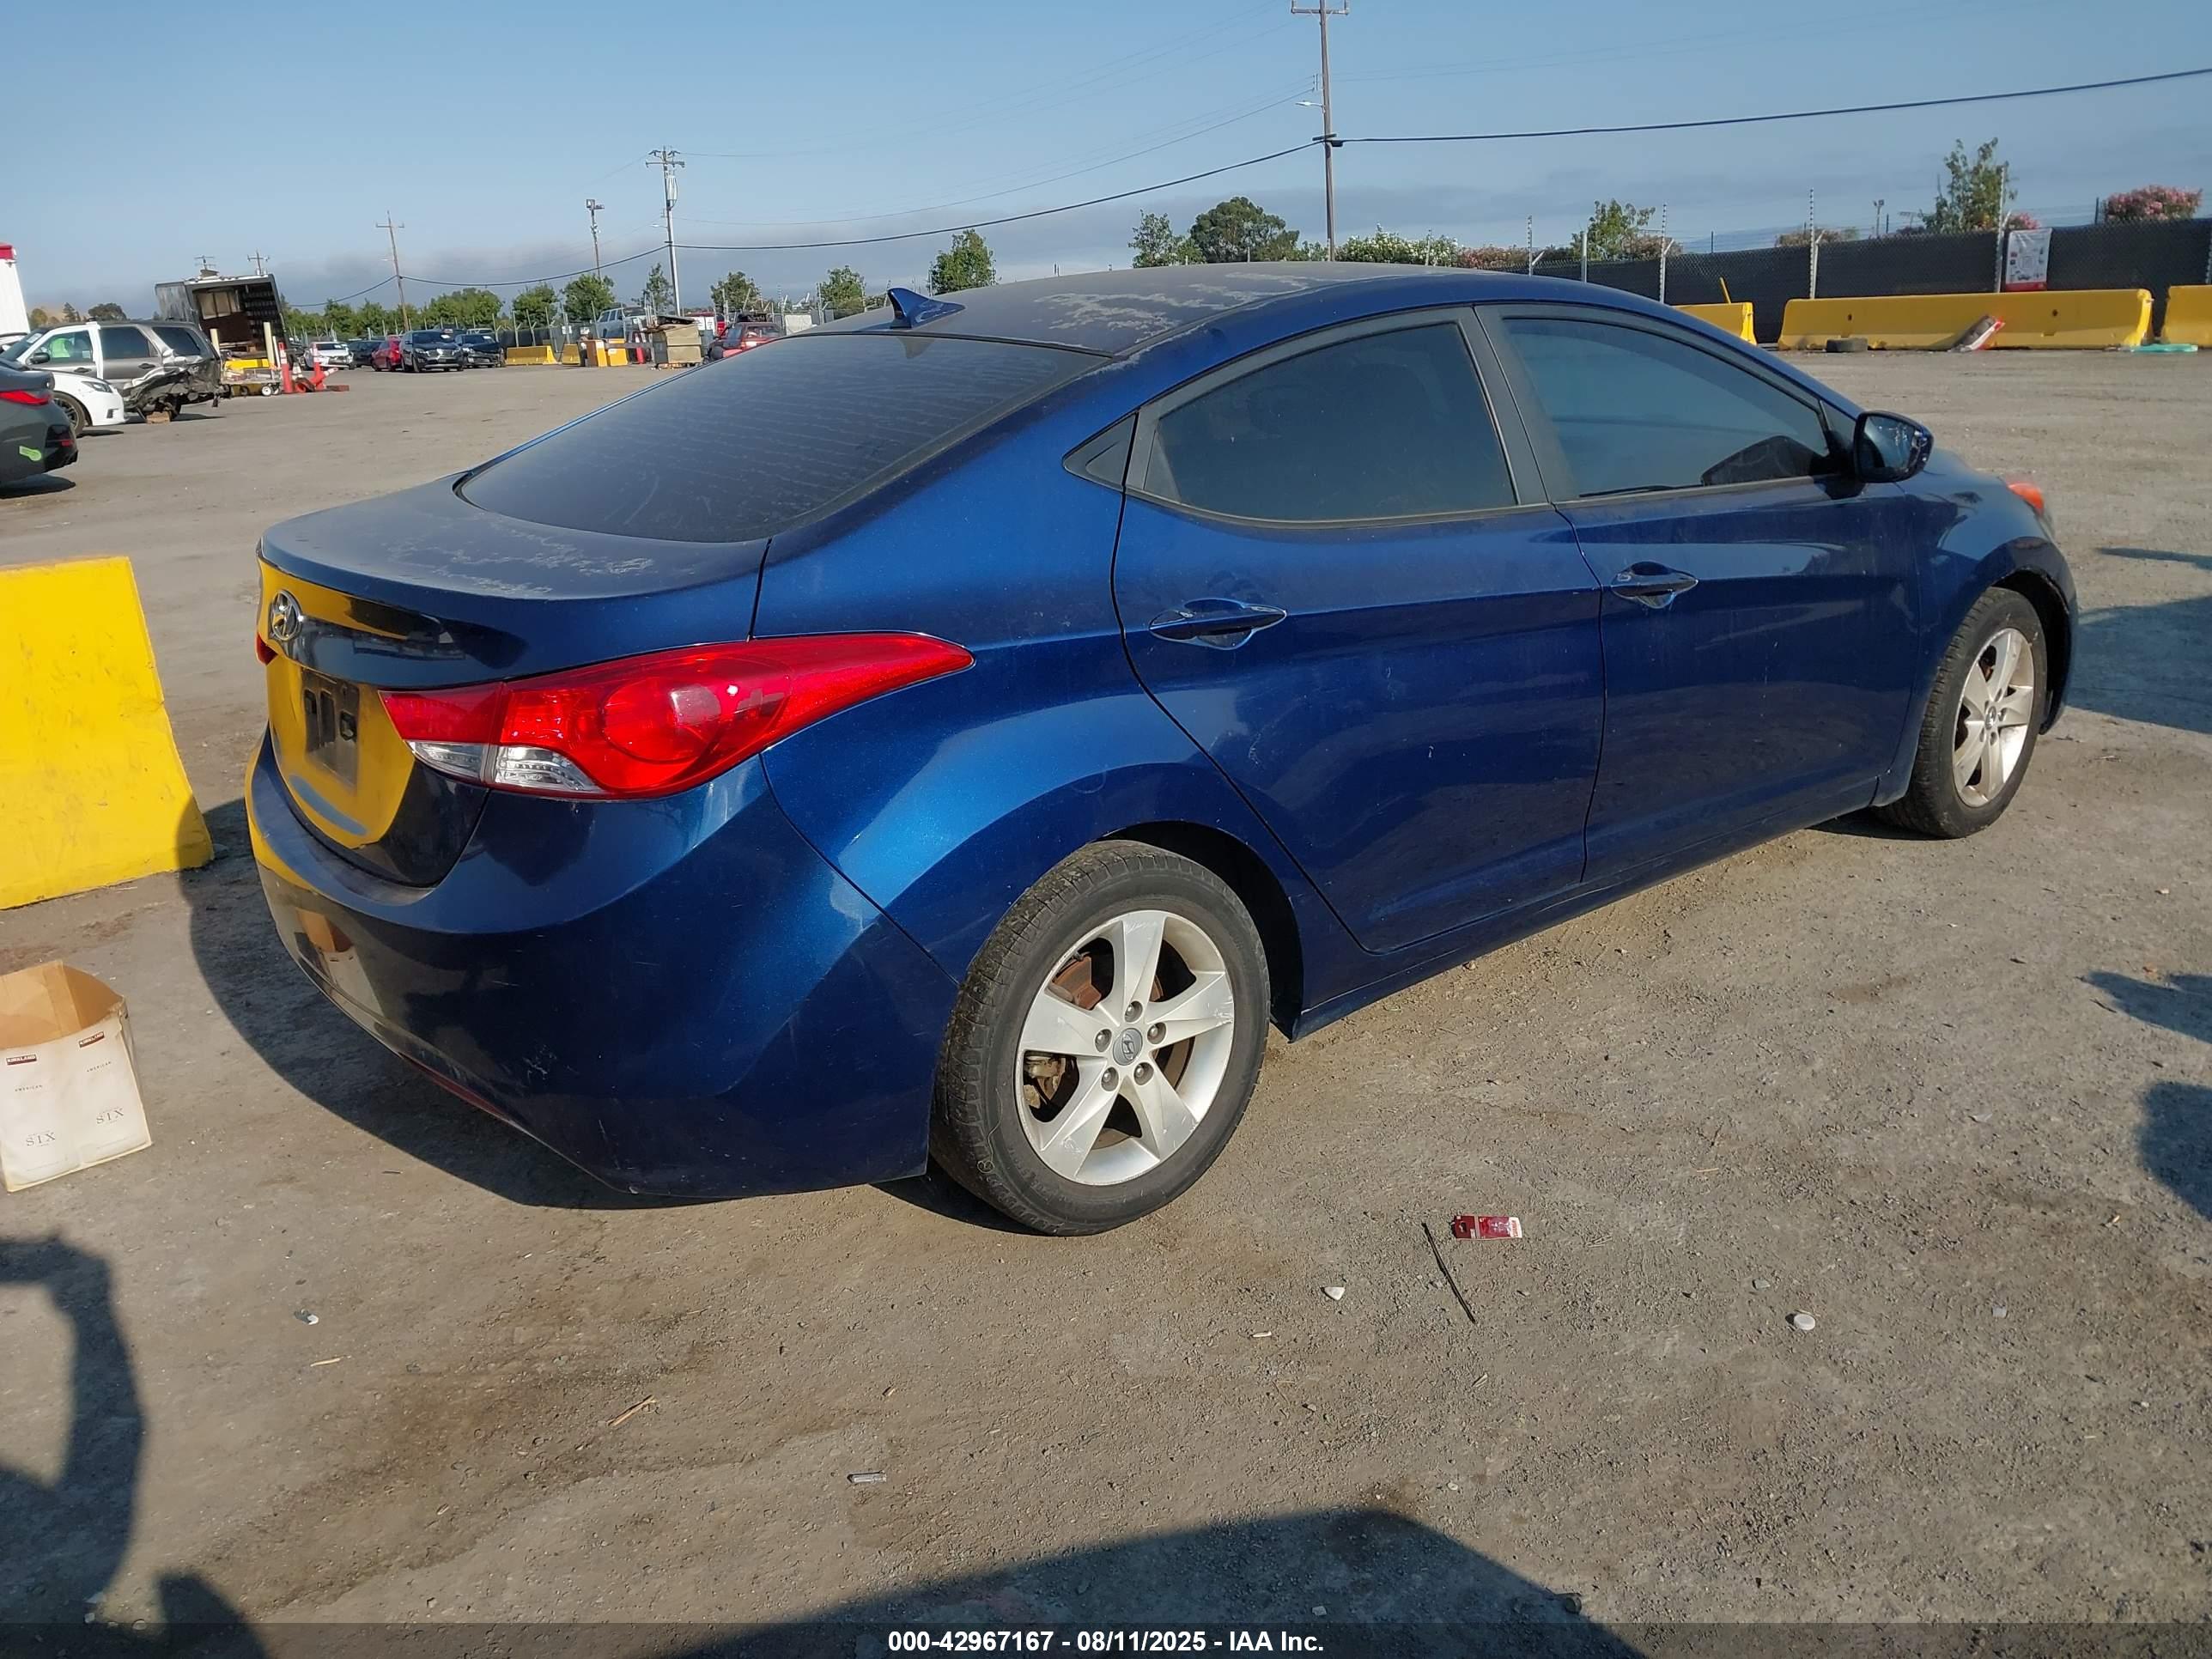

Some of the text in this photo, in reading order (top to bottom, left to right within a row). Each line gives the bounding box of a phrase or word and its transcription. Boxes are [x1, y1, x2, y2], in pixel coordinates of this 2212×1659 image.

[7, 1054, 36, 1064] KIRKLAND
[87, 1061, 112, 1073] AMERICAN
[96, 1108, 124, 1124] SIX
[26, 1132, 55, 1146] SIX
